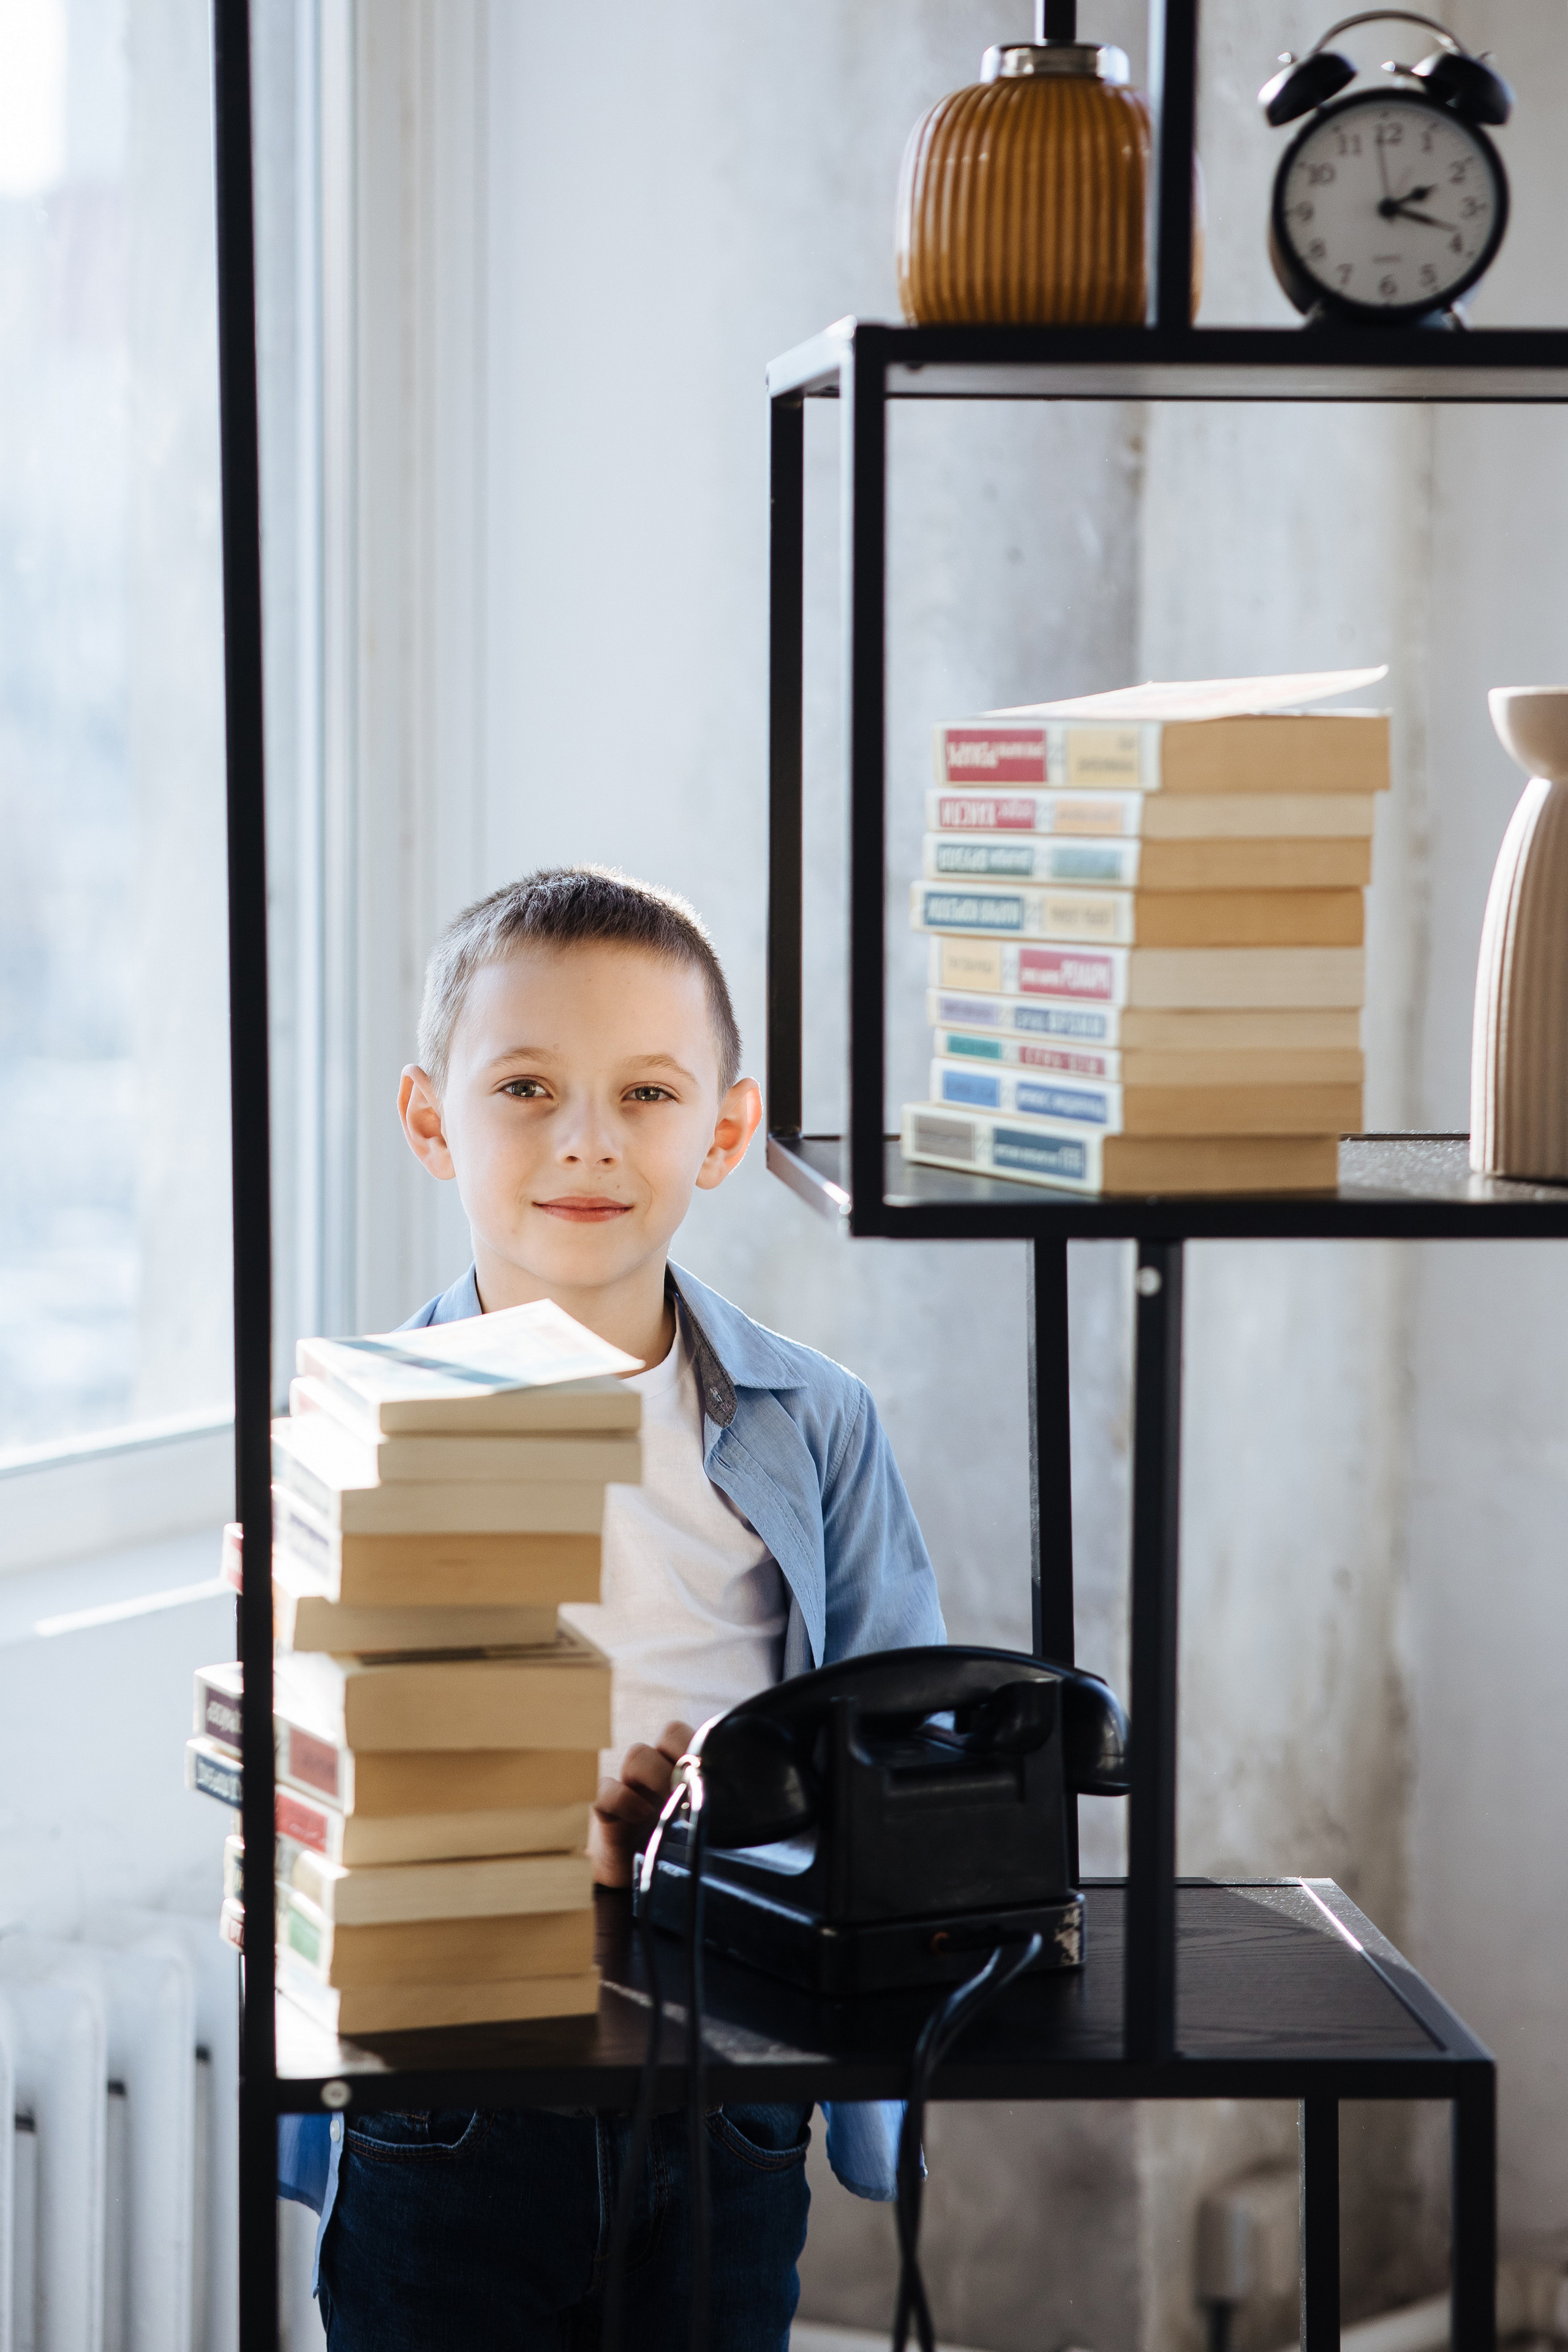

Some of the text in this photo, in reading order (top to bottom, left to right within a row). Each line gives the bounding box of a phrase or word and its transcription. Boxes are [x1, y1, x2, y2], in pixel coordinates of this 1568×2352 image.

[1339, 134, 1361, 157] 11
[1375, 123, 1402, 146] 12
[1421, 131, 1433, 153] 1
[1307, 162, 1336, 185] 10
[1449, 160, 1465, 184] 2
[1297, 201, 1314, 222] 9
[1462, 196, 1477, 219] 3
[1450, 234, 1463, 255] 4
[1337, 263, 1352, 285] 7
[1421, 263, 1436, 287] 5
[1379, 277, 1397, 297] 6
